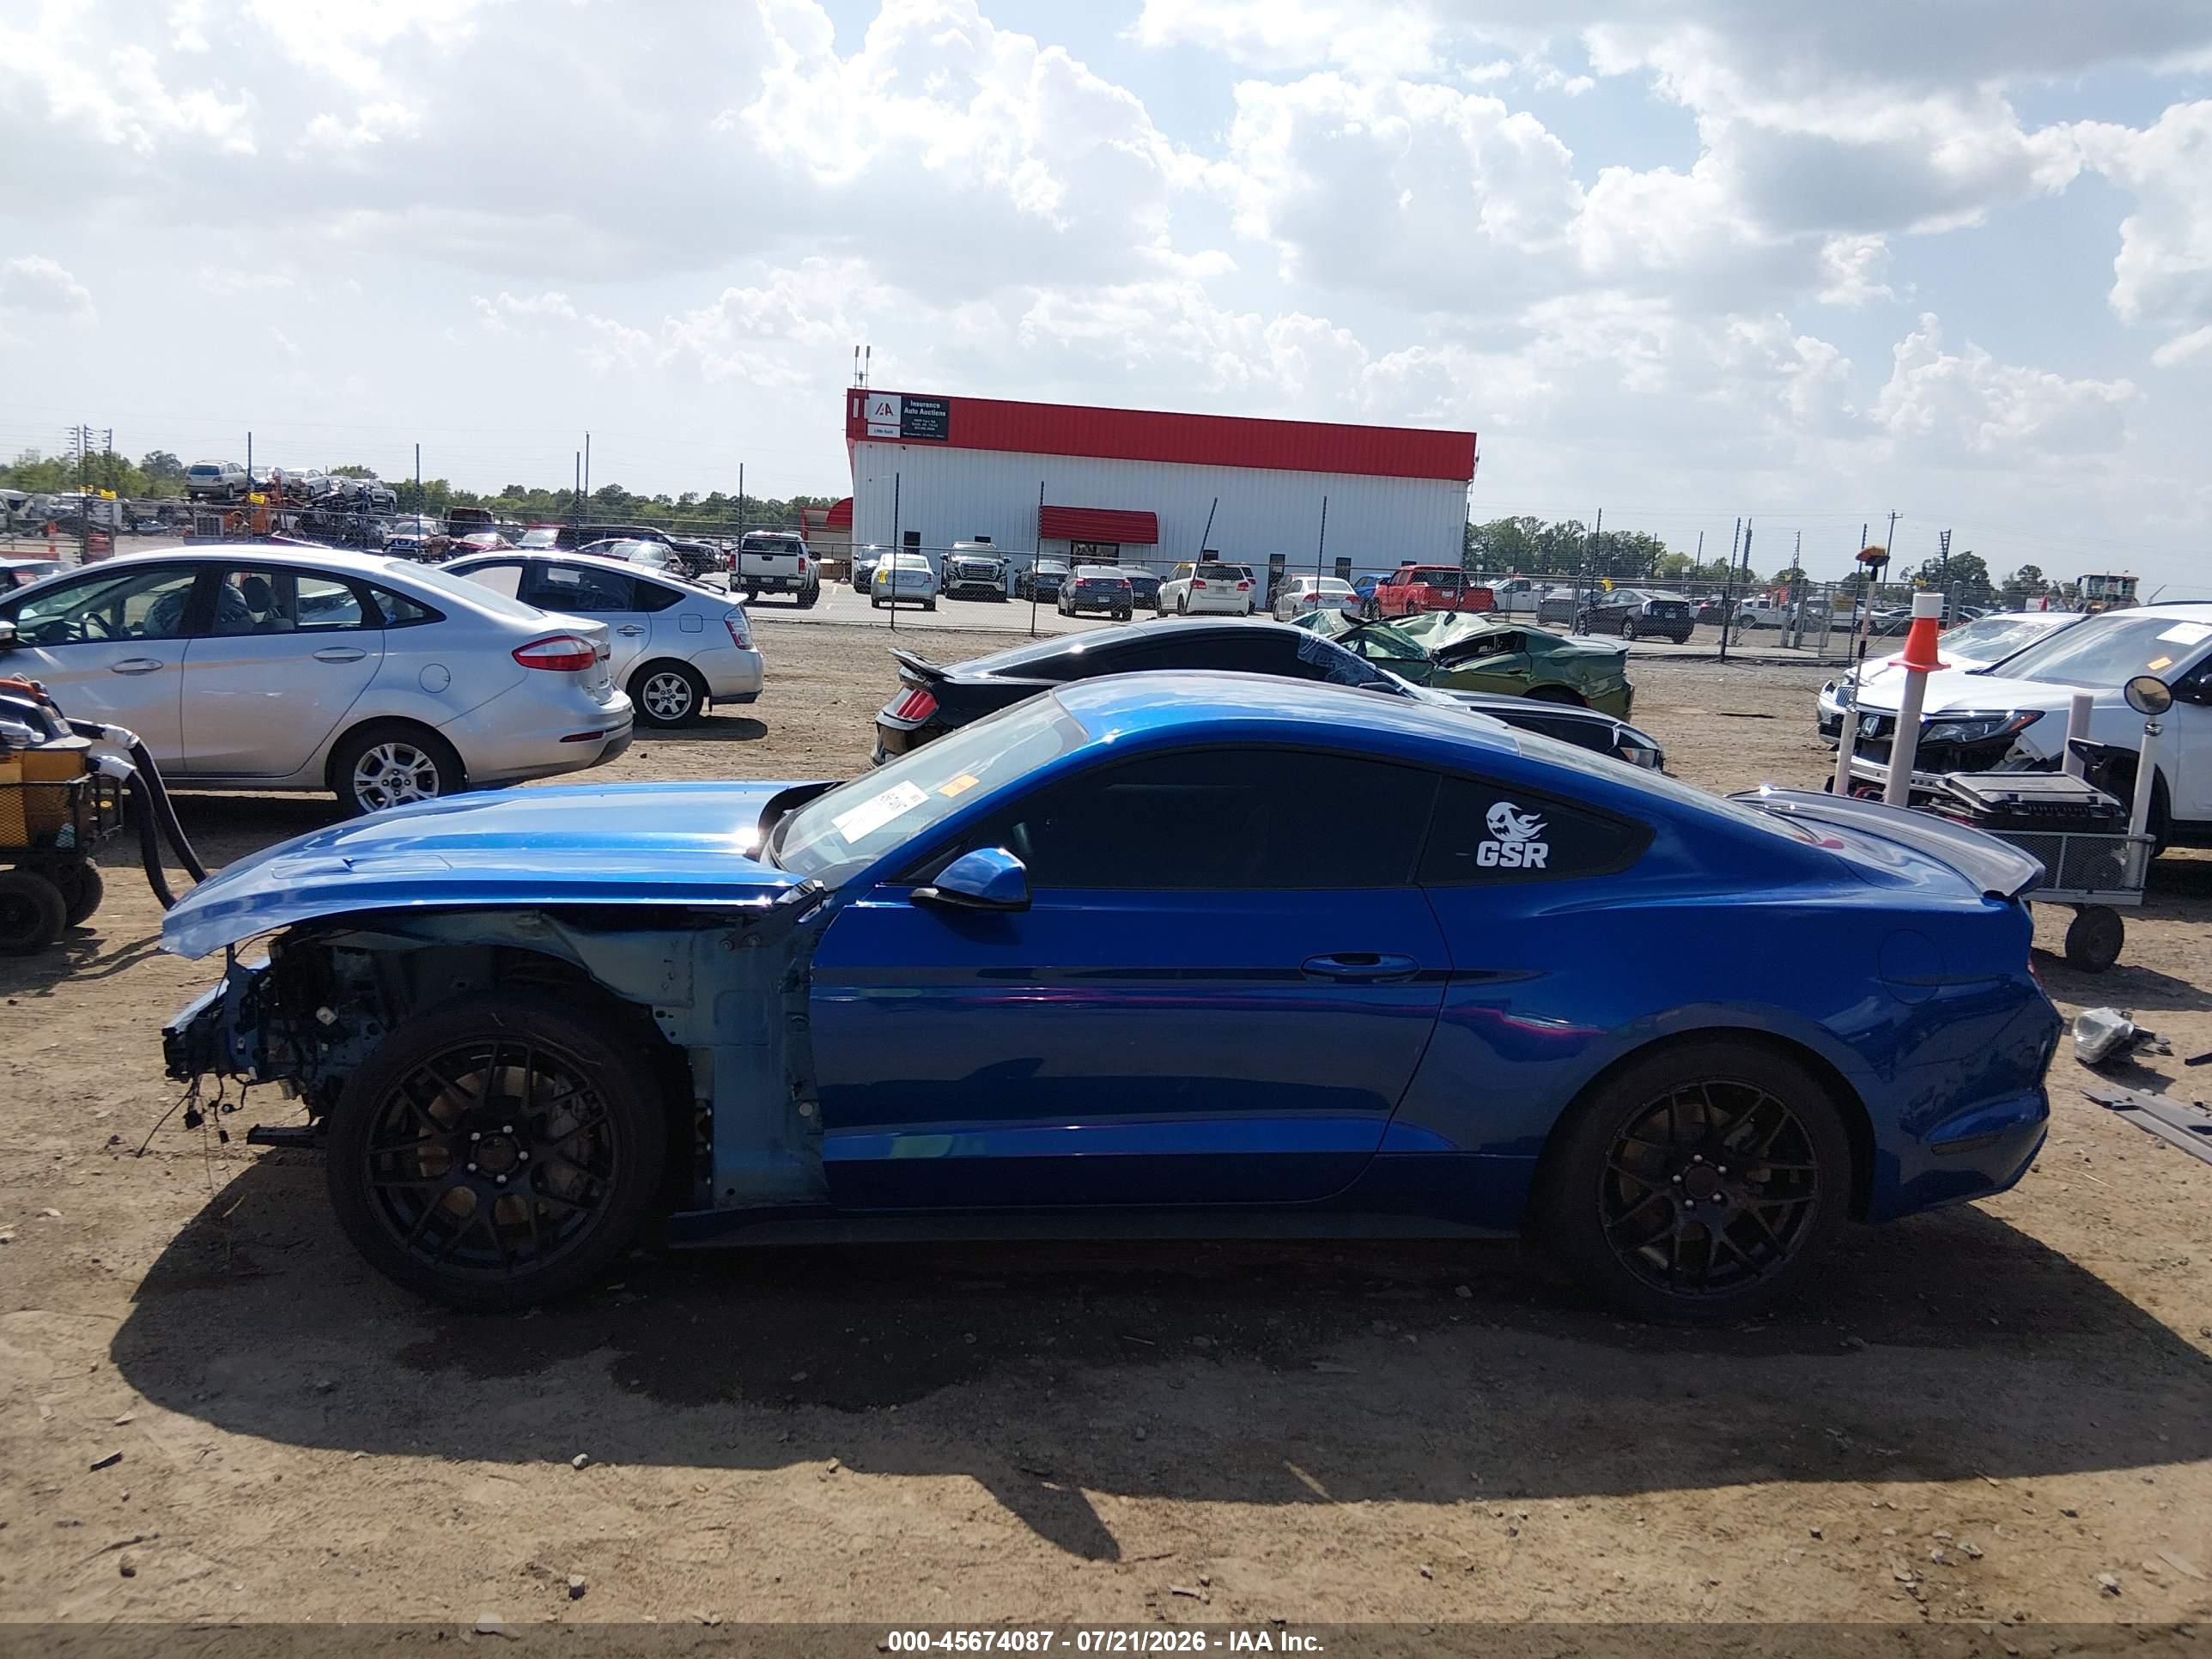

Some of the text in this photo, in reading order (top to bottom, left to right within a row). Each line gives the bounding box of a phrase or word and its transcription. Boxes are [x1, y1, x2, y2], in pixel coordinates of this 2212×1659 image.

[910, 399, 940, 409] Insurance
[904, 406, 946, 416] Auto Auctions
[1476, 841, 1549, 868] GSR
